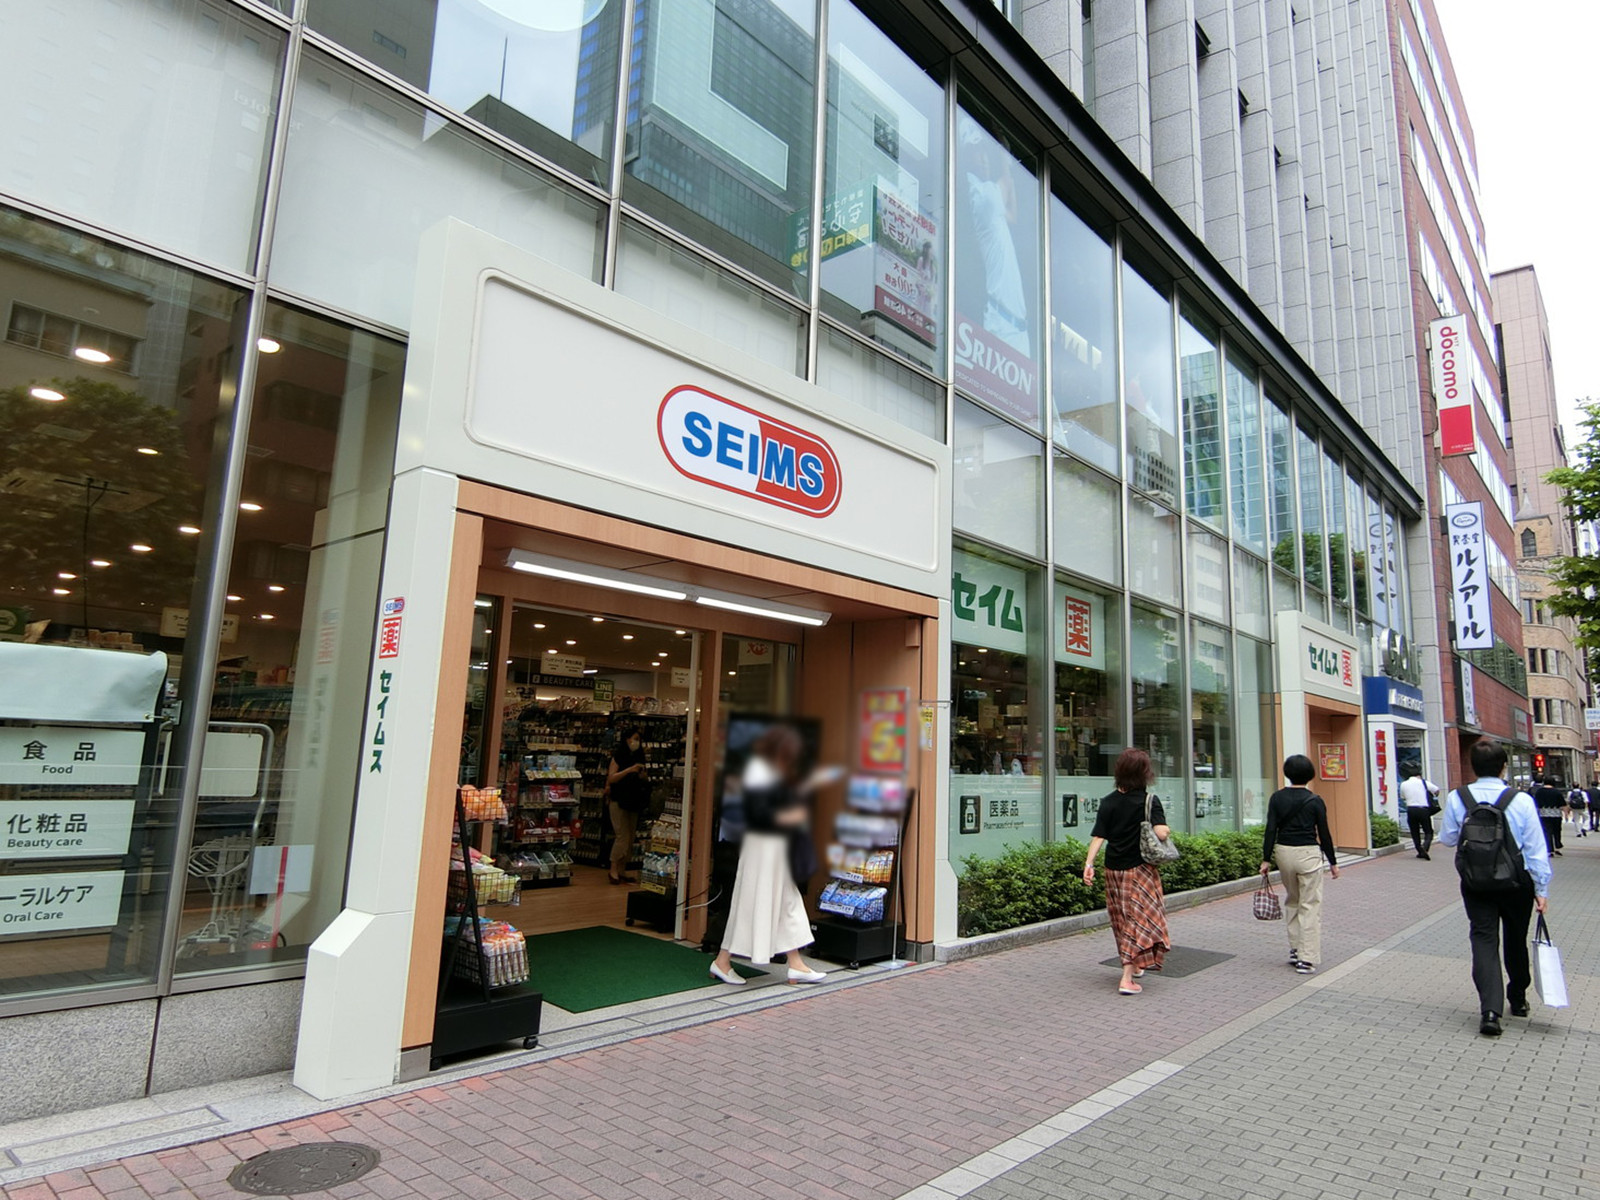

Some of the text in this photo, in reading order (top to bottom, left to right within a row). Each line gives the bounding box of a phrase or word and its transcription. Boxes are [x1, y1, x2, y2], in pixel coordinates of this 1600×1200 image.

[955, 322, 1033, 396] SRIXON
[1440, 326, 1458, 399] docomo
[682, 411, 824, 496] SEIMS
[952, 571, 1023, 633] セイム
[1457, 548, 1486, 640] ルノアール
[385, 601, 402, 612] SEIMS
[380, 619, 401, 656] 薬
[1066, 598, 1091, 655] 薬
[1308, 642, 1339, 678] セイムス
[543, 676, 573, 686] BEAUTY
[595, 683, 613, 691] LINE
[370, 669, 392, 774] セイムス
[23, 740, 97, 762] 食品
[42, 764, 74, 775] Food
[990, 800, 1019, 818] 医薬品
[1083, 797, 1102, 813] 化粧
[7, 813, 88, 835] 化粧品
[7, 837, 83, 850] Beauty care
[0, 885, 94, 907] ーラルケア
[3, 910, 63, 923] Oral Care
